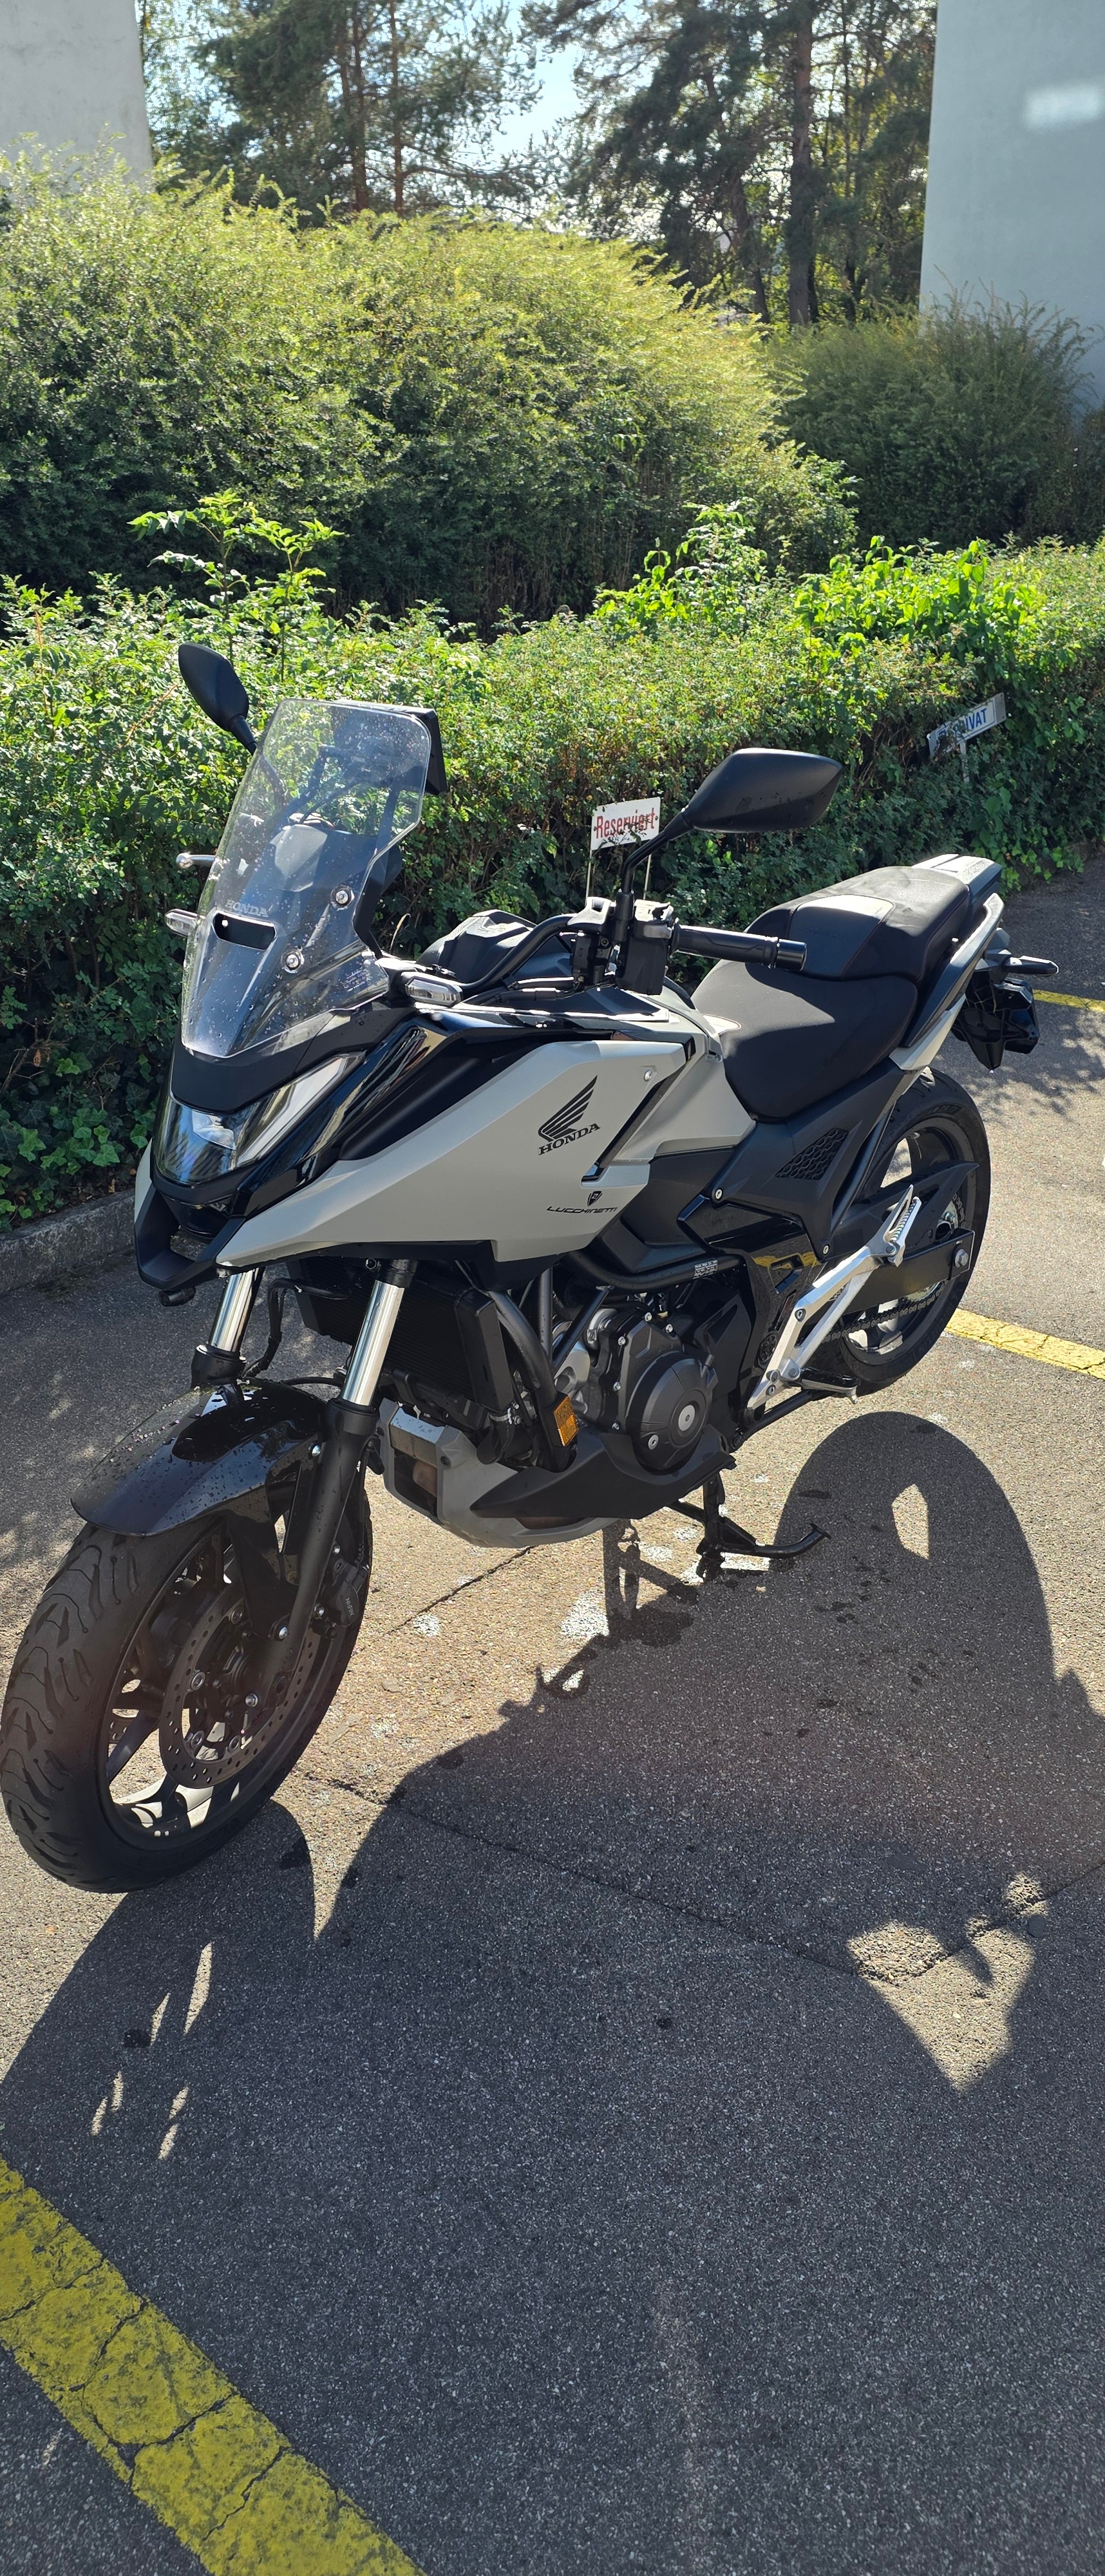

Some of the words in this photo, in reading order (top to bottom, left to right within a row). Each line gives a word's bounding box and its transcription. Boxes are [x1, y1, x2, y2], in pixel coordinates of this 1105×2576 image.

[955, 708, 987, 737] IVAT
[596, 807, 656, 839] Reserviert
[225, 898, 269, 918] HONDA
[538, 1122, 601, 1155] HONDA
